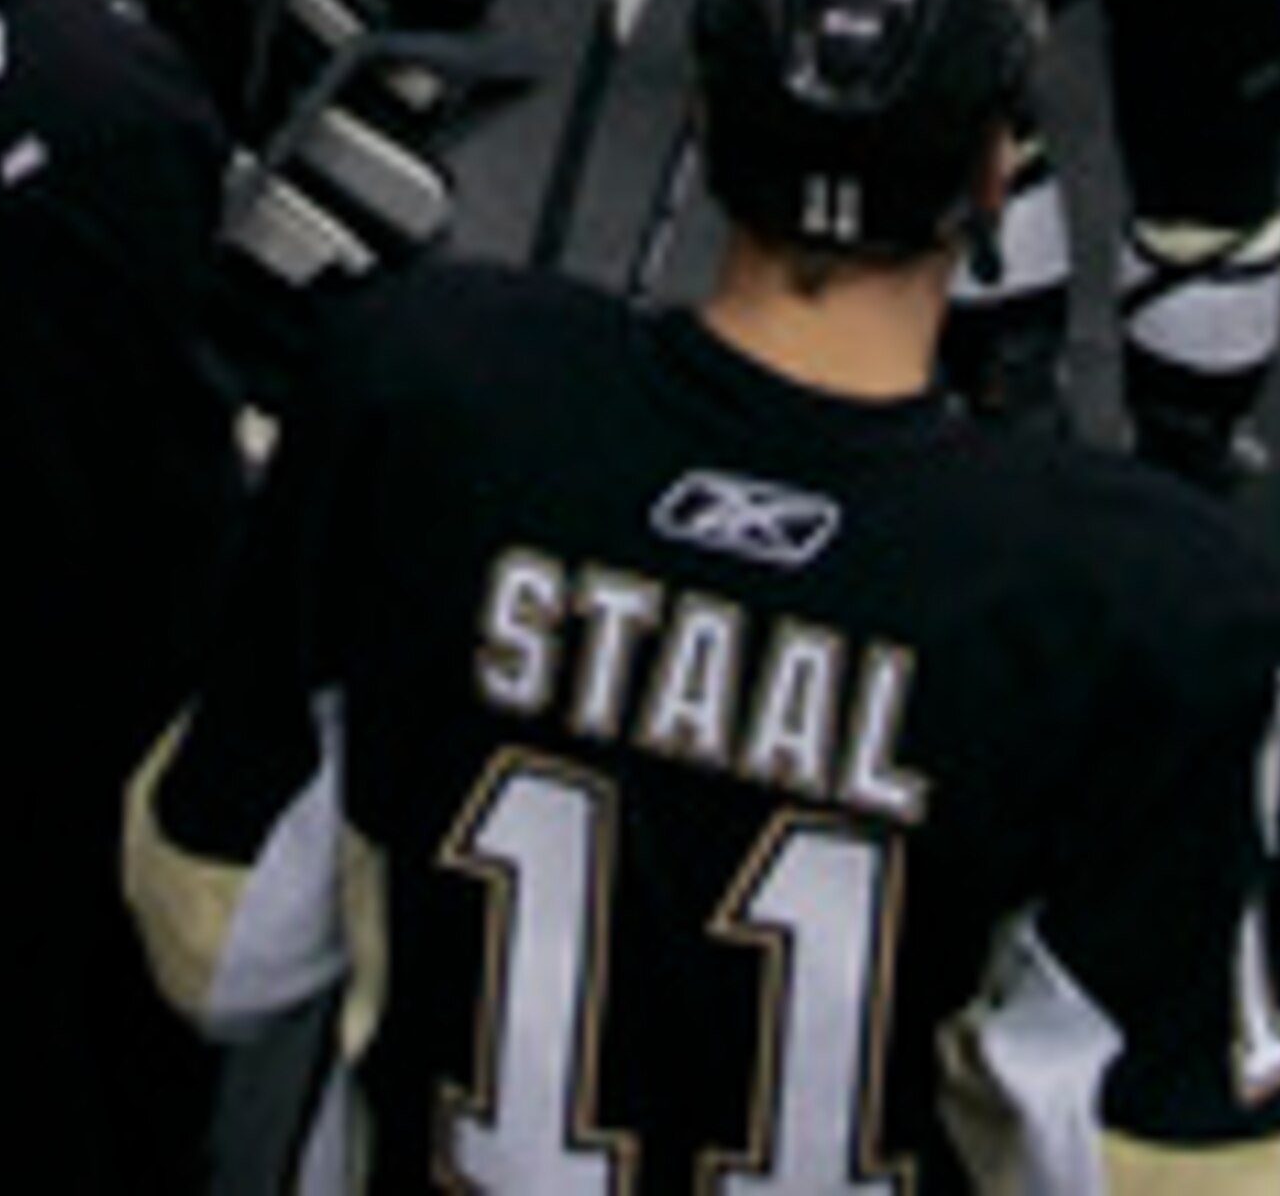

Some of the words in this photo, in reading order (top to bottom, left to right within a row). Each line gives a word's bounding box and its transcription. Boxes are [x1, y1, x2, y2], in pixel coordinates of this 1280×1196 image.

[803, 172, 863, 243] 11
[476, 546, 928, 824] STAAL
[437, 746, 918, 1196] 11
